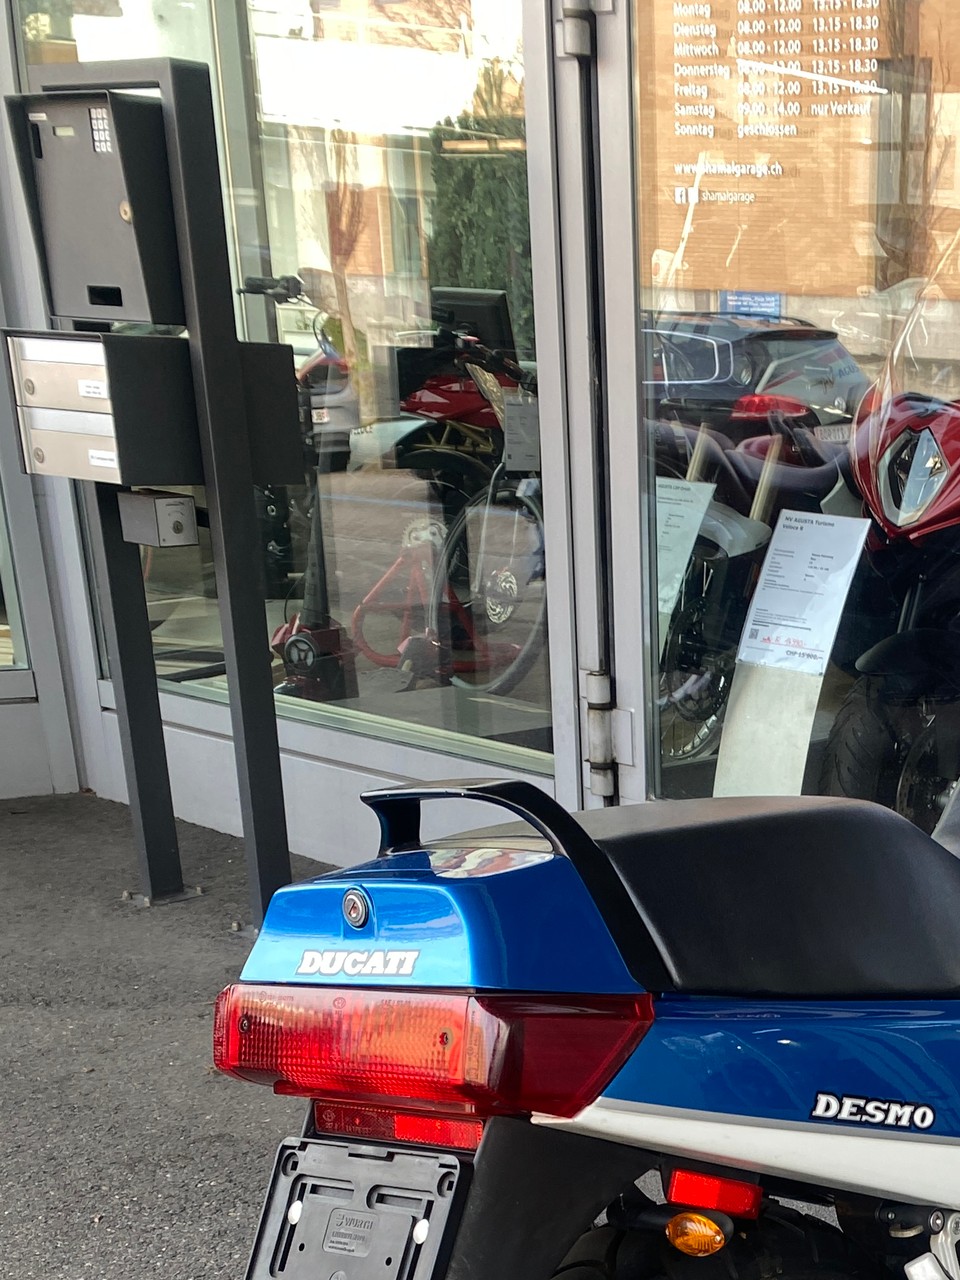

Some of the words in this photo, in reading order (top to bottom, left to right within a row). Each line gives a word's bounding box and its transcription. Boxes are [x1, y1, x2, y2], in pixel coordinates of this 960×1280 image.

[673, 2, 711, 18] Montag
[737, 0, 765, 13] 08.00
[773, 0, 801, 11] 12.00
[673, 23, 717, 38] Dienstag
[737, 19, 765, 34] 08.00
[773, 18, 801, 33] 12.00
[812, 17, 840, 31] 13.15
[850, 15, 879, 30] 18.30
[673, 41, 719, 57] Mittwoch
[737, 40, 765, 55] 08.00
[773, 39, 801, 54] 12.00
[812, 38, 840, 53] 13.15
[849, 37, 878, 52] 18.30
[673, 62, 730, 79] Donnerstag
[773, 60, 801, 74] 1200
[812, 60, 840, 74] 13.15
[848, 58, 878, 73] 18.30
[674, 83, 708, 98] Freitag
[737, 81, 765, 95] 08.00
[773, 80, 801, 95] 12.00
[812, 80, 840, 95] 13.15
[674, 101, 715, 119] Samstag
[737, 101, 765, 116] 09.00
[773, 100, 801, 116] 14.00
[810, 104, 829, 115] nur
[829, 101, 872, 116] Verkauf
[674, 122, 715, 138] Sonntag
[737, 122, 797, 138] geschlossen
[674, 160, 783, 178] wwwhamalgarage.ch
[701, 189, 755, 204] shamalgarage
[838, 363, 859, 379] AGUS
[296, 950, 419, 976] DUCATI
[811, 1093, 935, 1129] DESMO
